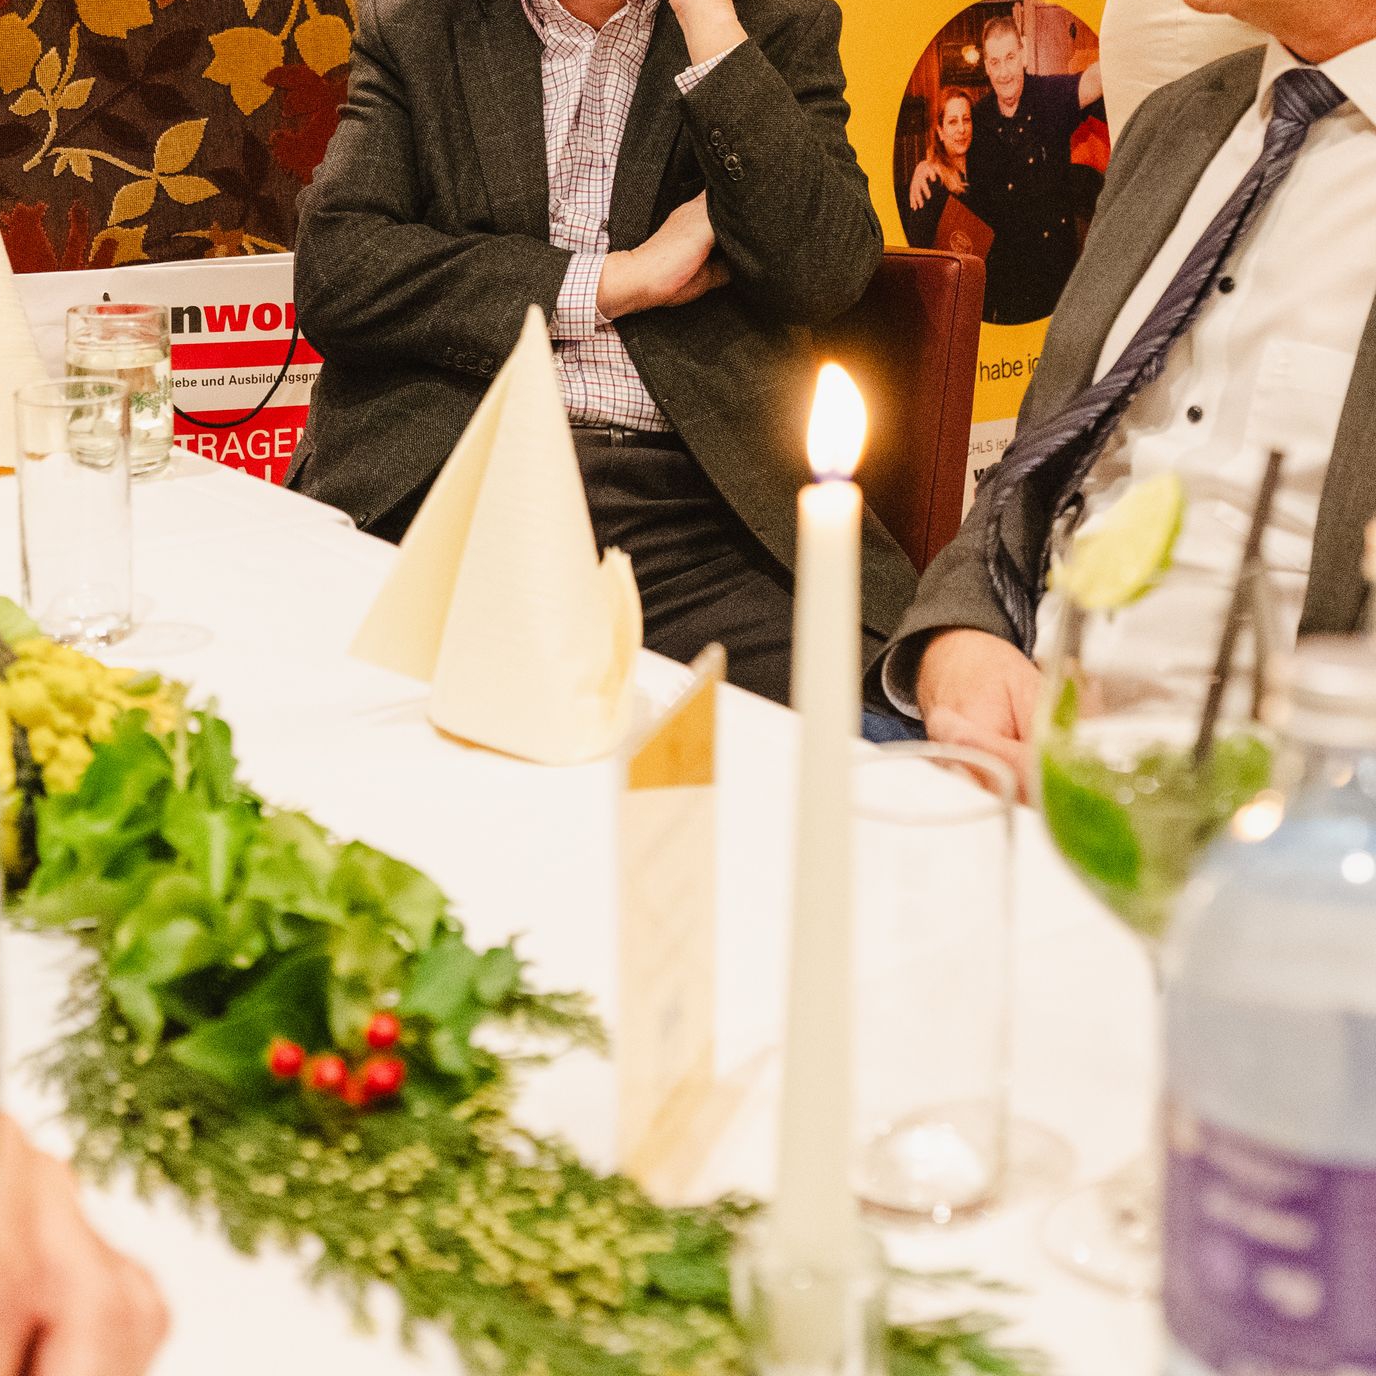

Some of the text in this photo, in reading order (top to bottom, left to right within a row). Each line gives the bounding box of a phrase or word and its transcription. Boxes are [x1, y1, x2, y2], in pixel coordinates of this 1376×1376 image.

[979, 353, 1040, 382] habe ic
[170, 372, 320, 388] iebe und Ausbildungsgm
